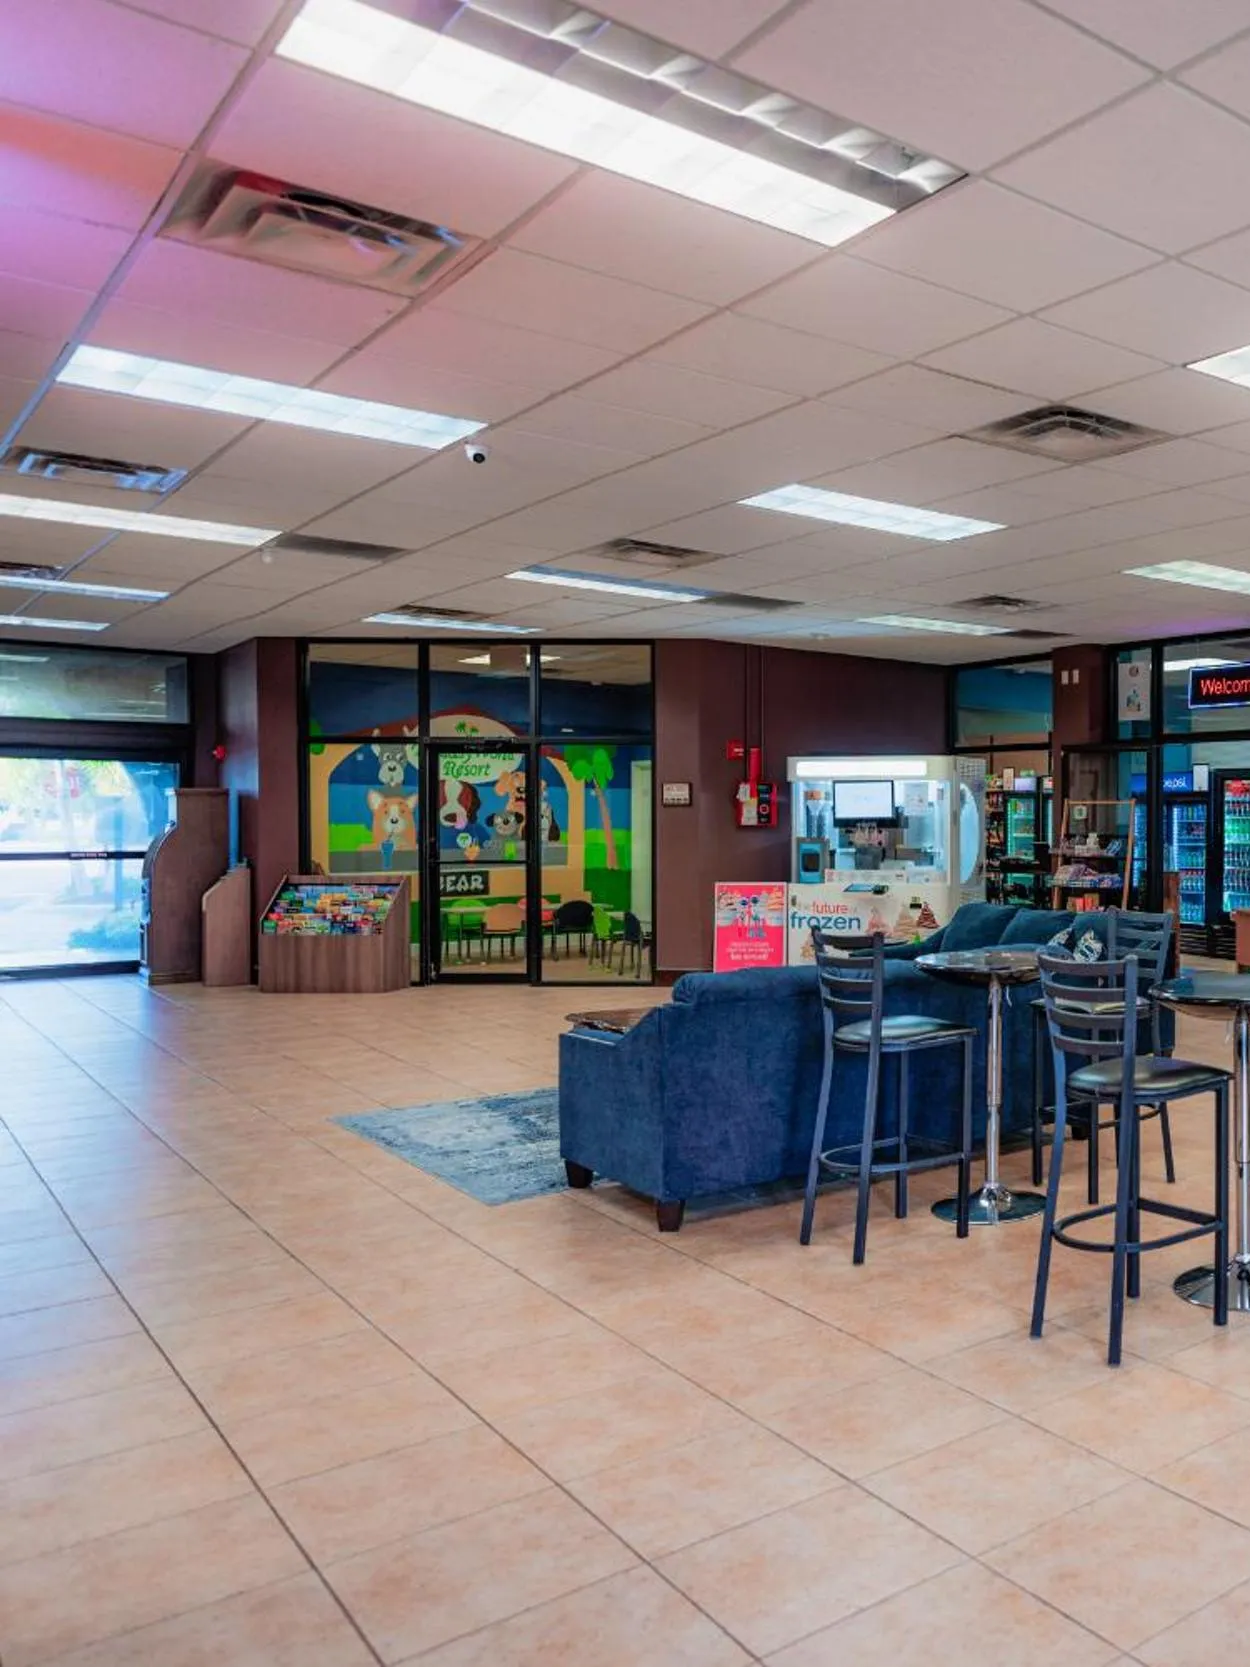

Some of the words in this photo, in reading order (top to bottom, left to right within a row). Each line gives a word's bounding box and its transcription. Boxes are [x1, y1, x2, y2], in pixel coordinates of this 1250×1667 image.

[443, 760, 491, 779] Resort
[440, 874, 484, 892] EAR
[812, 901, 849, 914] future
[790, 911, 861, 930] frozen
